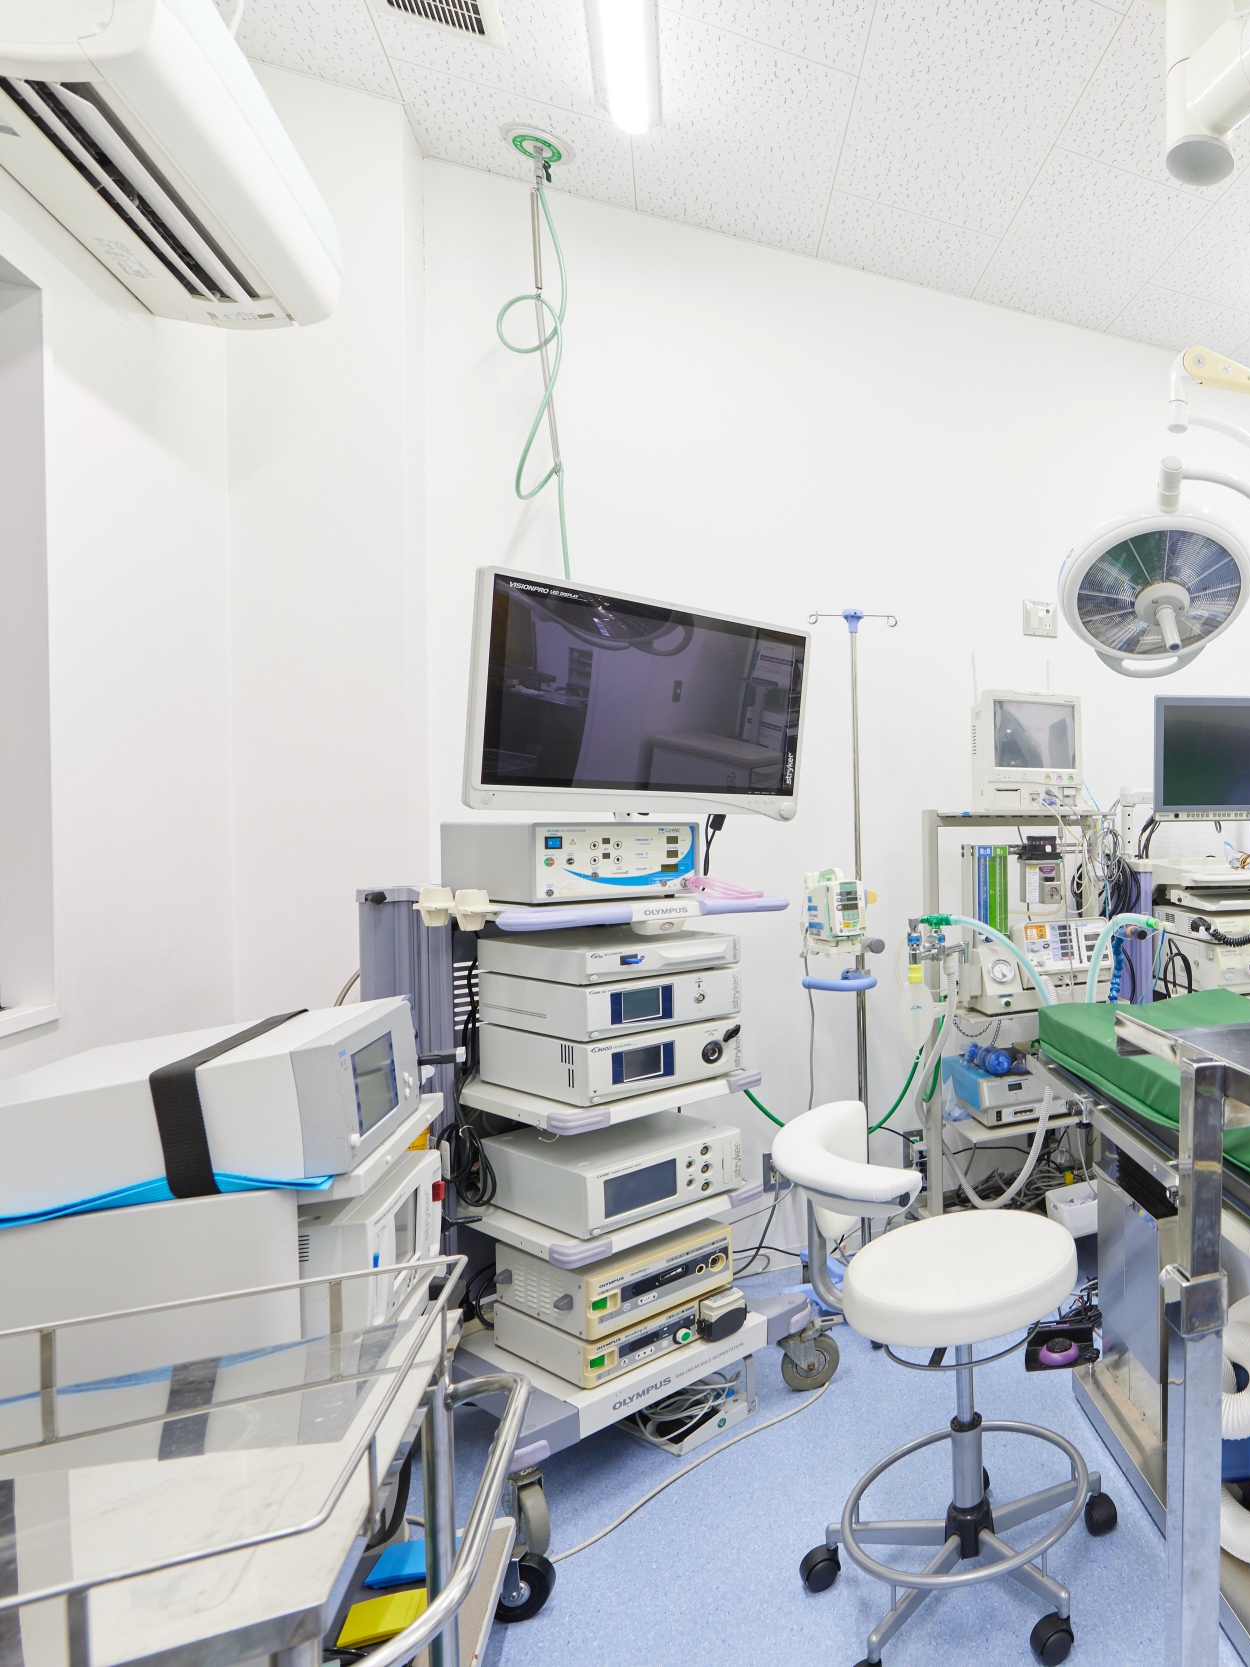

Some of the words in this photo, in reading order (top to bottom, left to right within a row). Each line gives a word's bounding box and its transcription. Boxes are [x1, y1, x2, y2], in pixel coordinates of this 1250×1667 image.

[509, 581, 550, 594] VISIONPRO
[785, 751, 794, 785] stryker
[643, 906, 688, 916] OLYMPUS
[731, 974, 740, 1010] stryker
[733, 1142, 742, 1179] stryker
[598, 1276, 625, 1289] OLYMPUS
[596, 1337, 622, 1351] OLYMPUS
[612, 1376, 672, 1411] OLYMPUS
[693, 1356, 712, 1372] MOBILE
[710, 1342, 745, 1361] WORKSTATION
